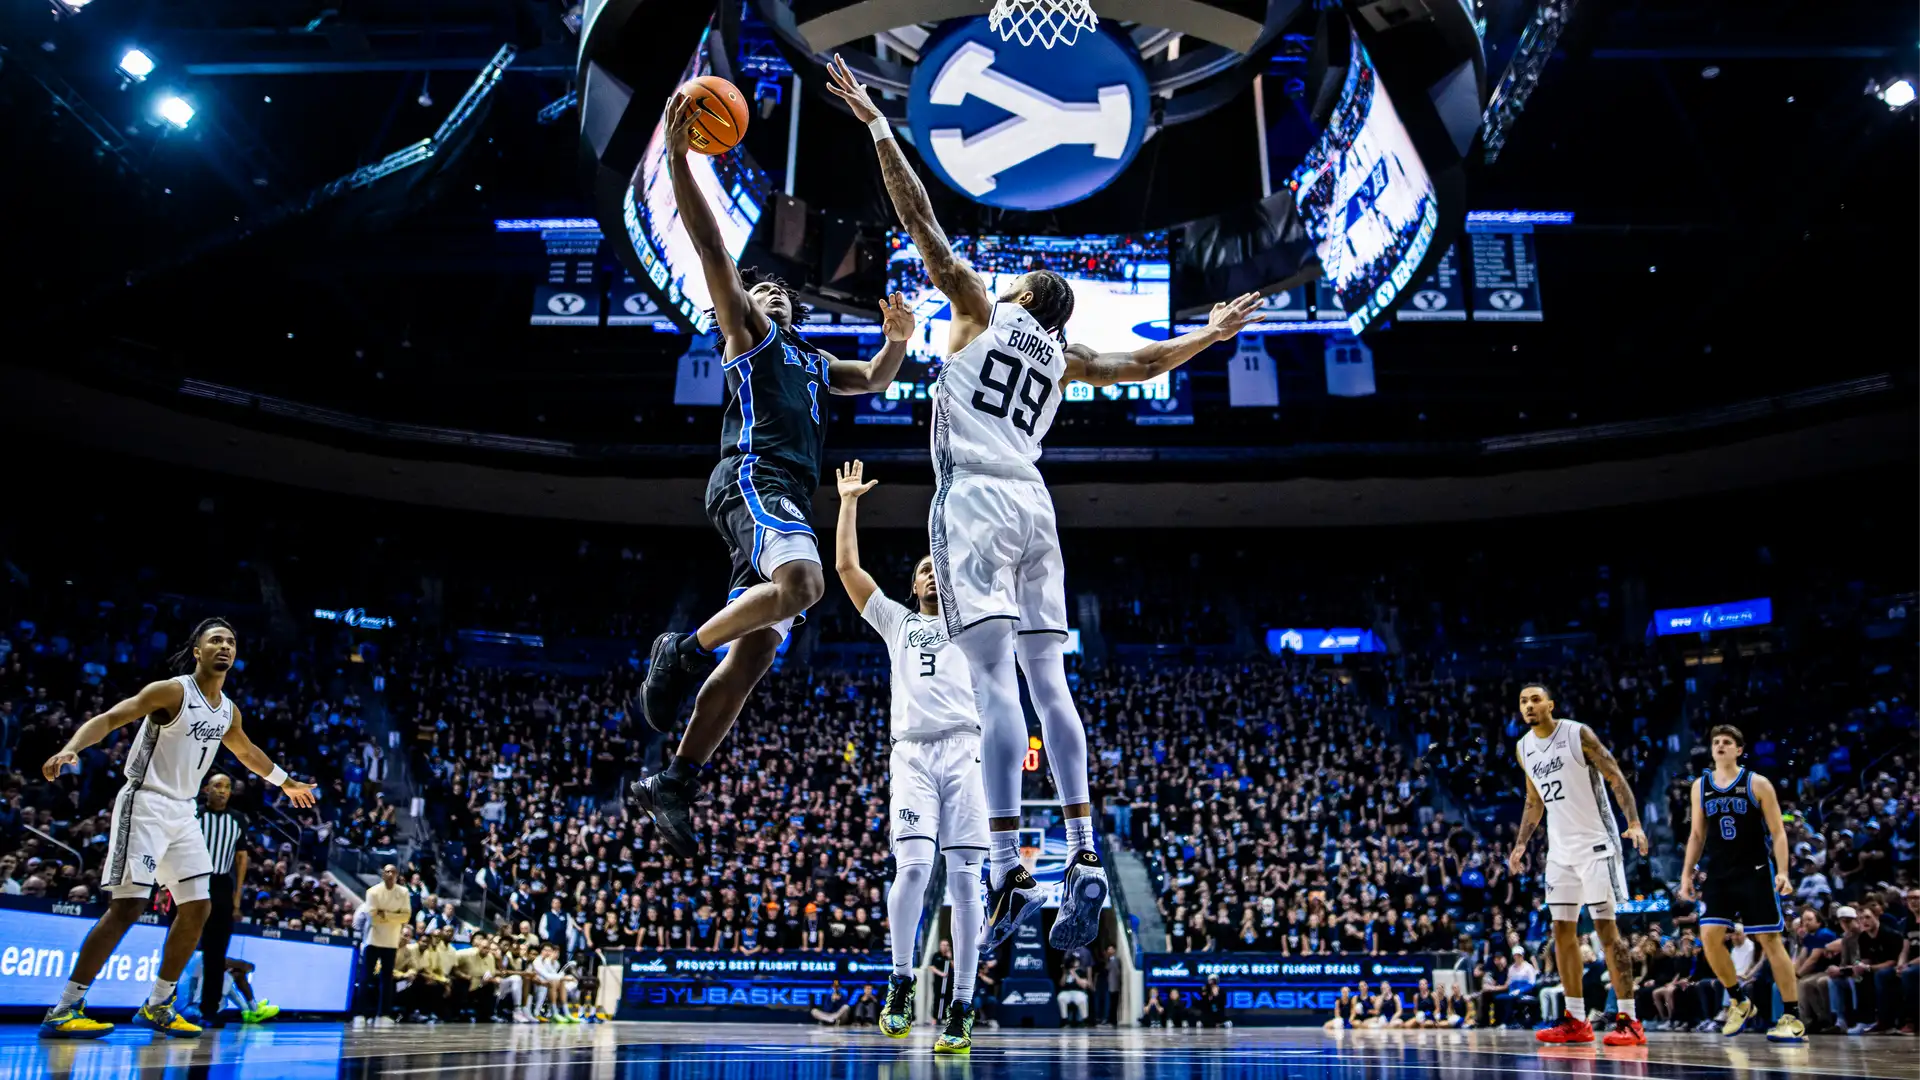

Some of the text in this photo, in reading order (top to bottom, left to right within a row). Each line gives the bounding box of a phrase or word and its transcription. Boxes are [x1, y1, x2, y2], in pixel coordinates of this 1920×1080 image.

[930, 41, 1132, 197] Y
[1007, 329, 1055, 366] BURKS
[807, 380, 820, 425] 1
[971, 349, 1053, 437] 99
[920, 652, 936, 677] 3
[197, 746, 208, 770] 1
[1532, 756, 1564, 780] Knights
[1541, 780, 1566, 803] 22
[1705, 796, 1748, 817] BYU
[1720, 815, 1737, 841] 6
[135, 949, 160, 982] at
[676, 960, 726, 970] PROVO'S
[728, 960, 757, 971] BEST
[759, 961, 798, 971] FLIGHT
[801, 961, 836, 971] DEALS
[1197, 964, 1249, 975] PROVO'S
[1251, 964, 1280, 975] BEST
[1282, 964, 1321, 975] FLIGHT
[1324, 964, 1360, 975] DEALS
